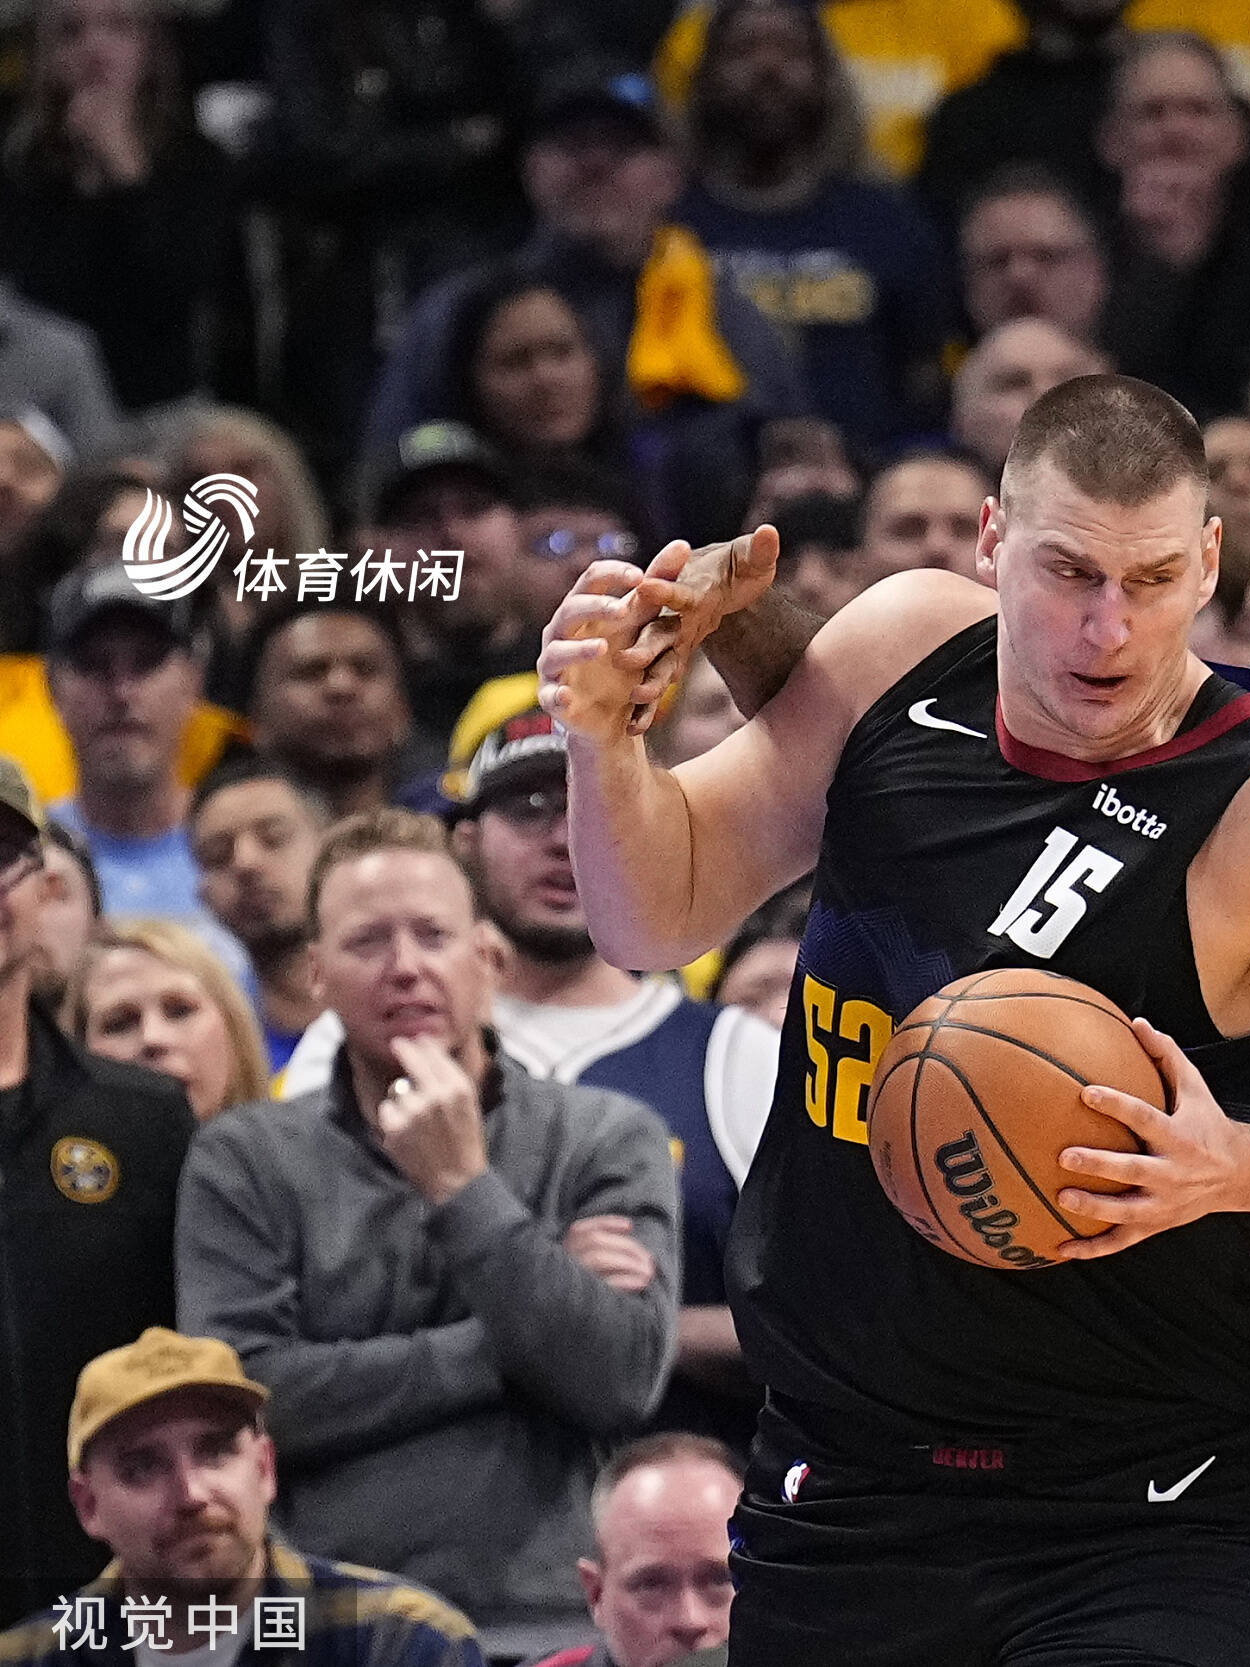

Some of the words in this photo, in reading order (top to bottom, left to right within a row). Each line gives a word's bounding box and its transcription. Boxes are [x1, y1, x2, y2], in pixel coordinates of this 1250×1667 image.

[1092, 783, 1167, 839] ibotta
[987, 826, 1124, 959] 15
[803, 974, 896, 1146] 52
